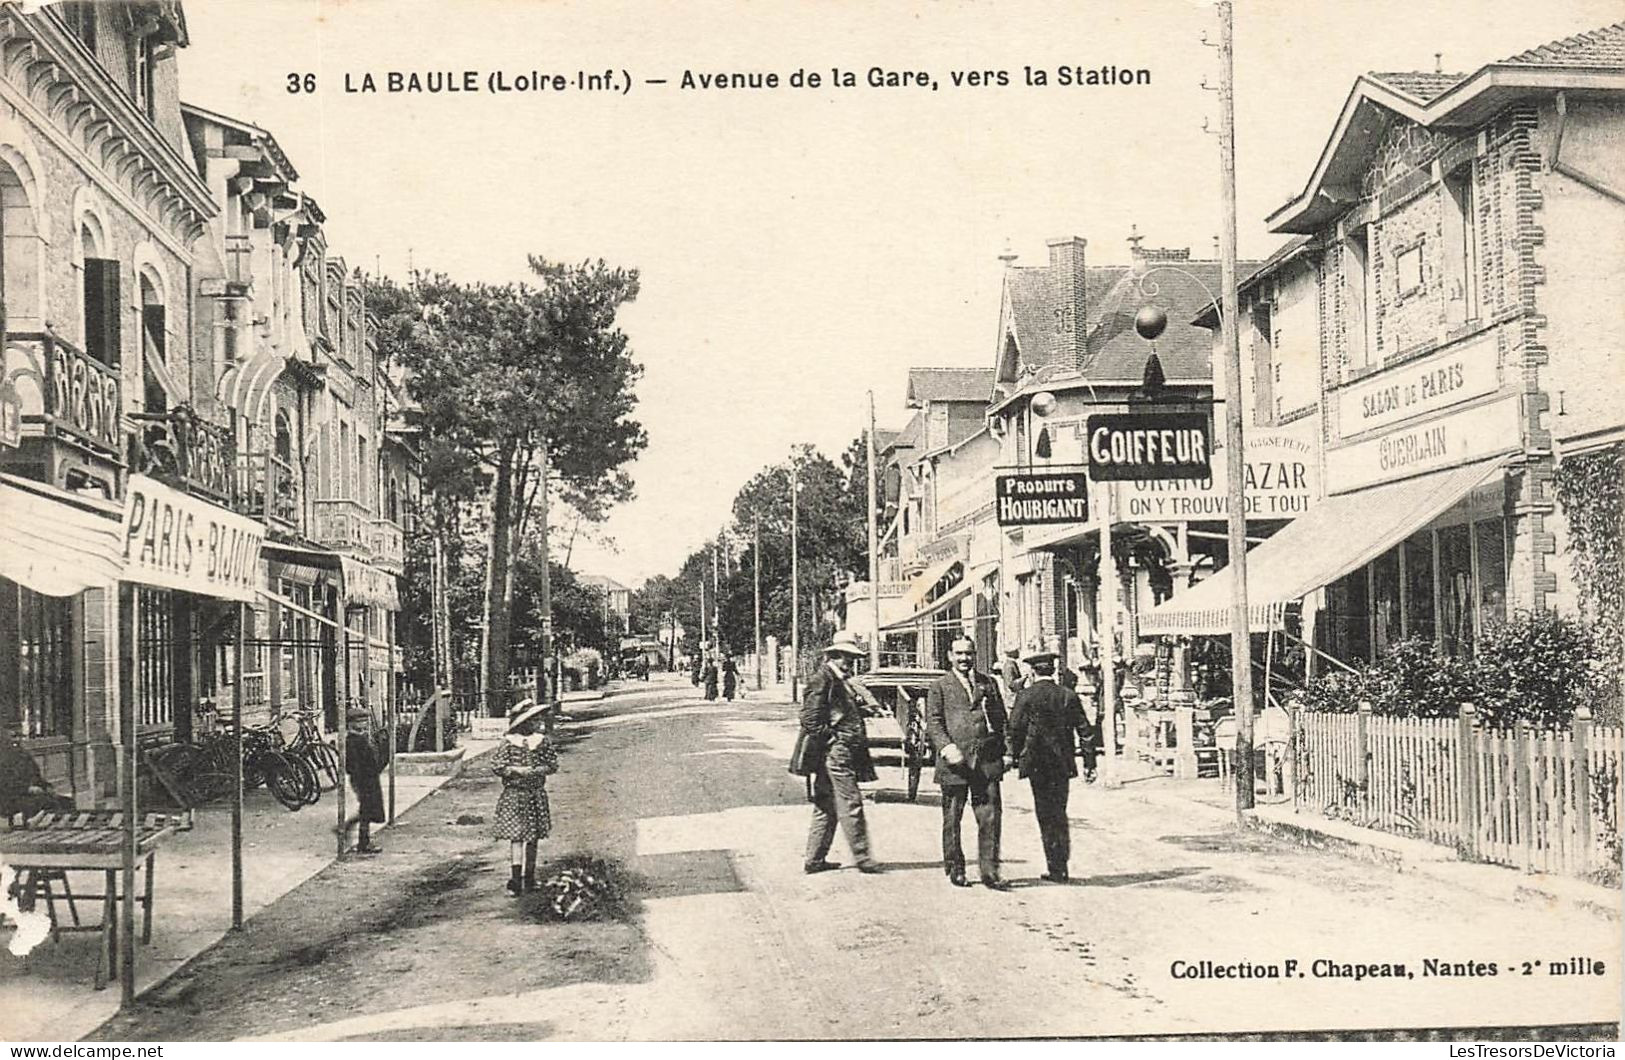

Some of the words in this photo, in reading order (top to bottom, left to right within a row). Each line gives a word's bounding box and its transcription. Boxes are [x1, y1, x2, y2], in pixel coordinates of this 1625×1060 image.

[1363, 386, 1399, 418] SALON
[1421, 362, 1464, 399] PARIS
[1090, 427, 1205, 465] COIFFEUR
[1380, 426, 1447, 471] GUERLAIN
[1006, 477, 1076, 494] PRODUITS
[1243, 462, 1307, 490] AZAR
[1000, 496, 1085, 520] HOUBIGANT
[1130, 497, 1151, 515] ON
[1157, 497, 1166, 515] Y
[1269, 494, 1311, 513] TOUT
[122, 491, 194, 575] PARIS
